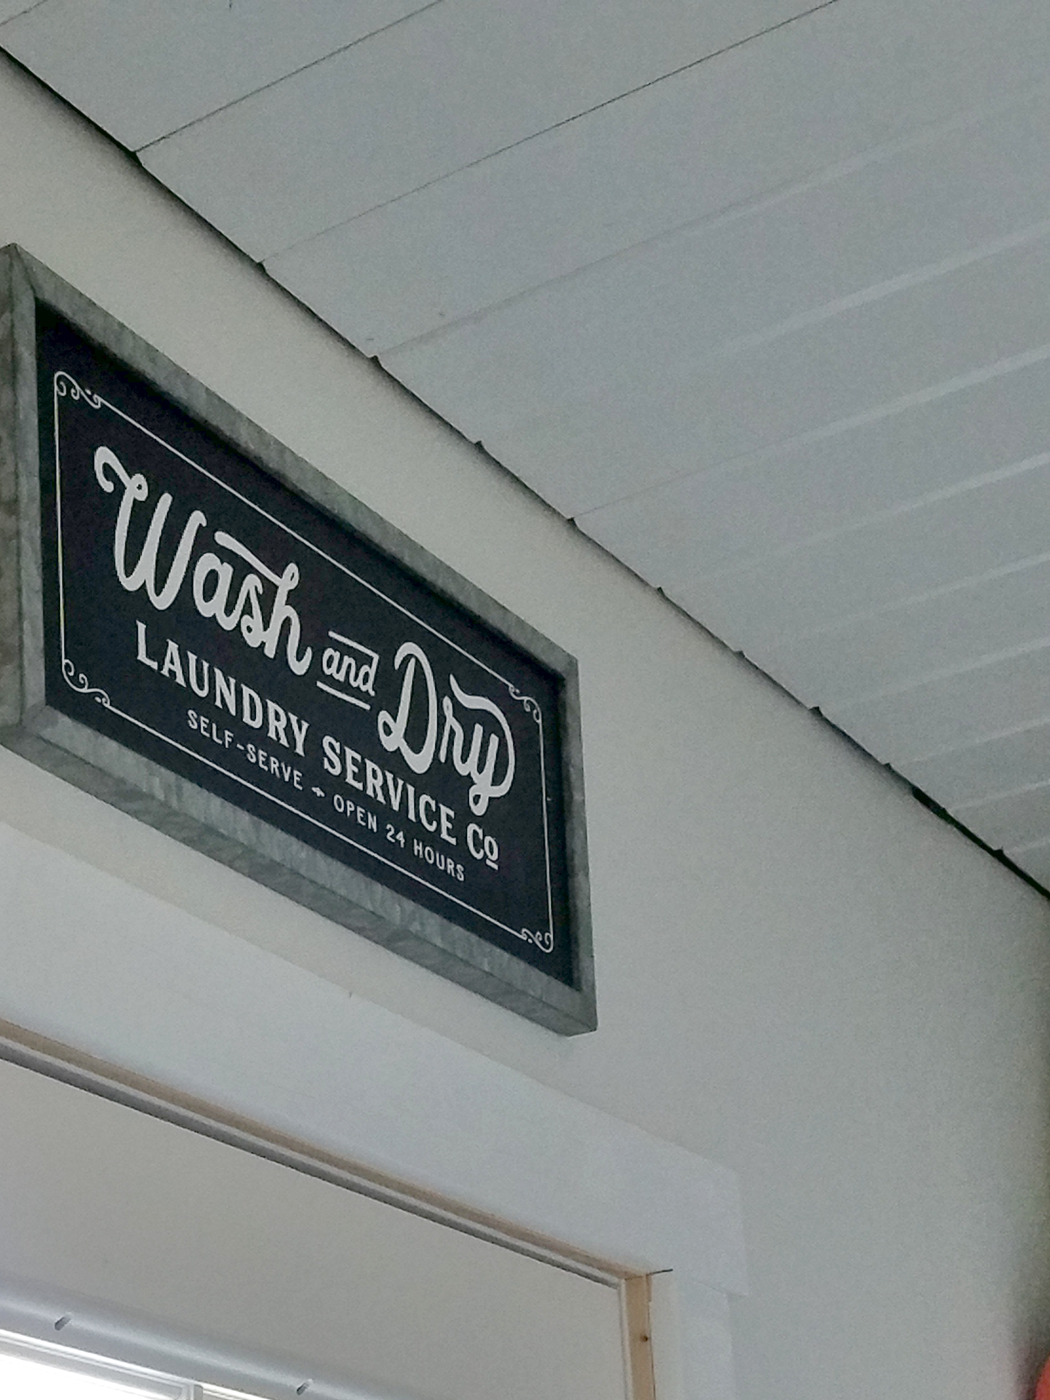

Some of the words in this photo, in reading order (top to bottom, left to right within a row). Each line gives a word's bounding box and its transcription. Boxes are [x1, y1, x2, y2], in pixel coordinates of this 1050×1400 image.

[93, 445, 313, 676] Wash
[322, 630, 380, 697] and
[377, 641, 516, 816] Dry
[135, 619, 310, 757] LAUNDRY
[322, 735, 457, 846] SERVICE
[187, 709, 303, 791] SELF-SERVE
[333, 794, 377, 833] OPEN
[385, 823, 405, 848] 24
[413, 838, 465, 882] HOURS
